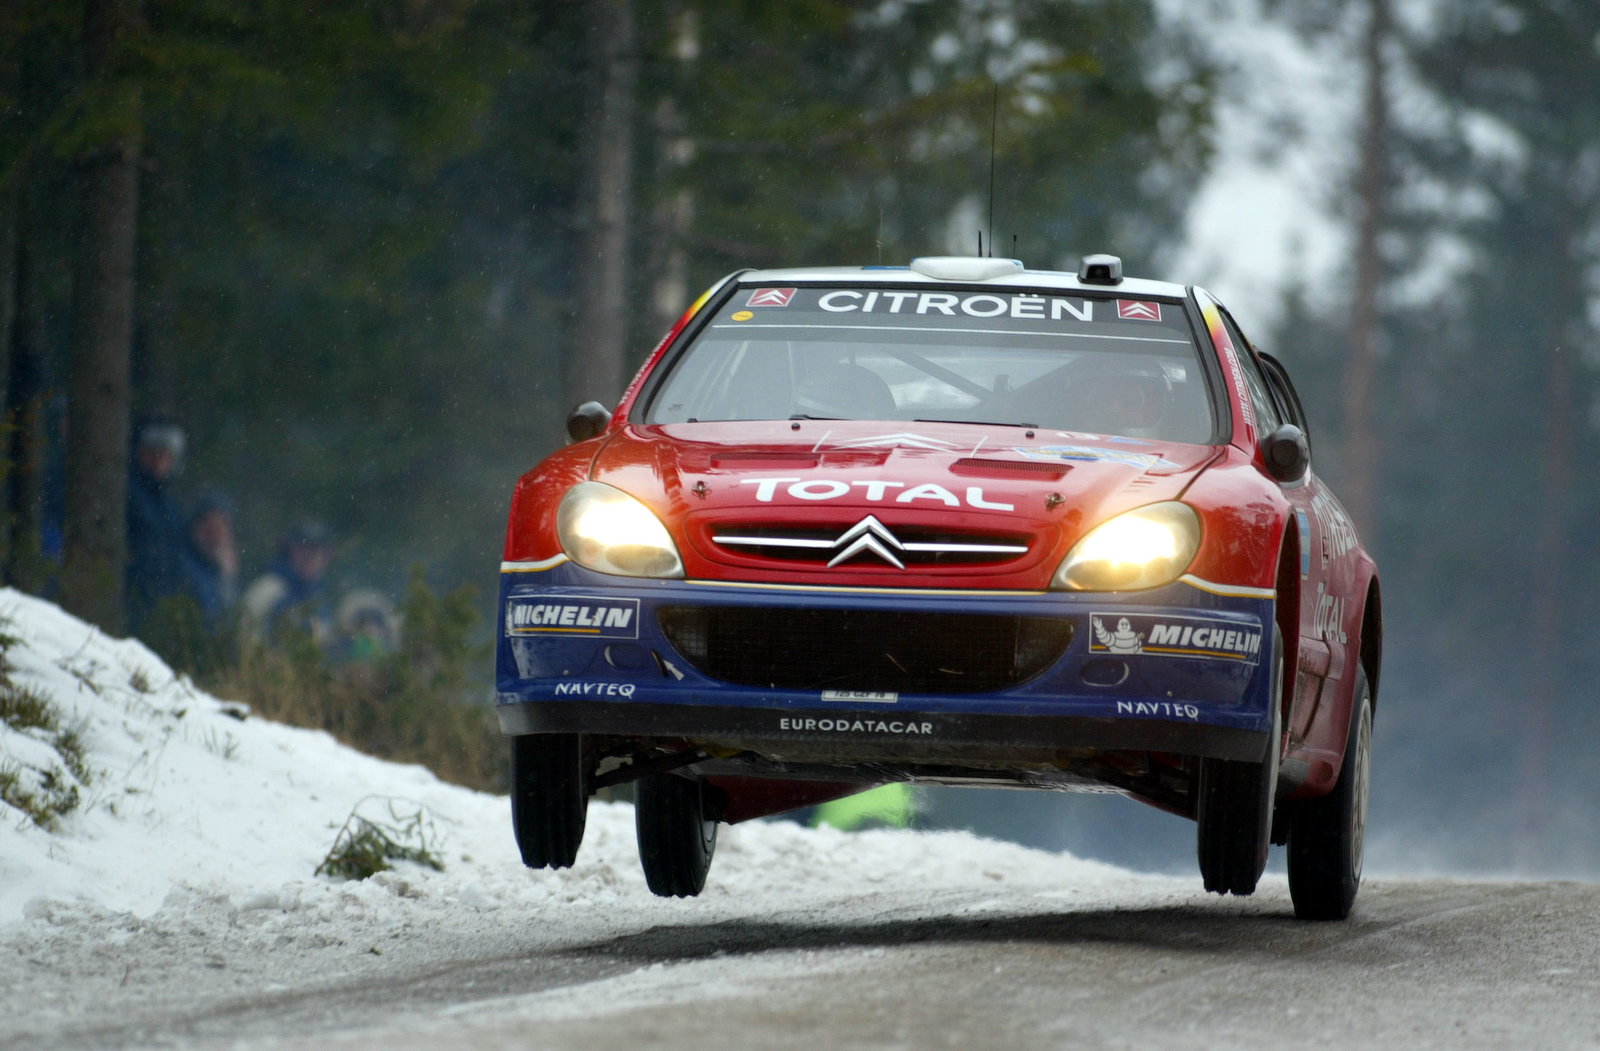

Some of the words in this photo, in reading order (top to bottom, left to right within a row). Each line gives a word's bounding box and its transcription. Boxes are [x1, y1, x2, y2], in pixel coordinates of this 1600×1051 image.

[818, 291, 1093, 322] CITROËN
[741, 477, 1014, 511] TOTAL
[514, 604, 633, 628] MICHELIN
[1314, 582, 1347, 644] TOTAL
[1148, 624, 1261, 654] MICHELIN
[555, 682, 635, 699] NAVTEQ
[1117, 701, 1199, 722] NAVTEQ
[780, 718, 933, 735] EURODATACAR
